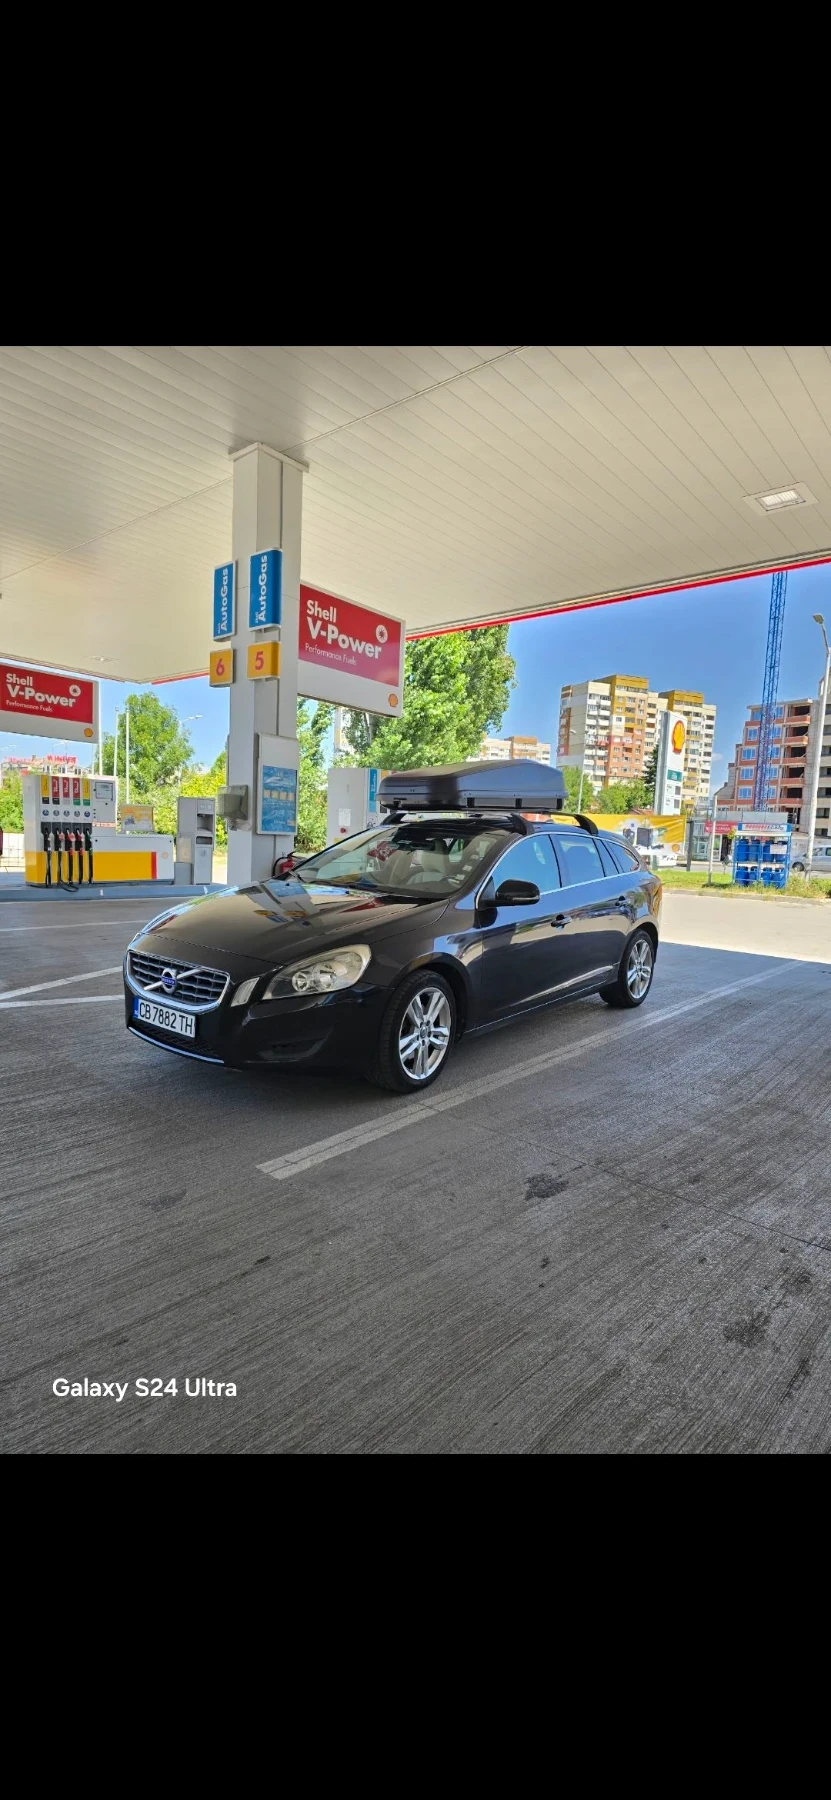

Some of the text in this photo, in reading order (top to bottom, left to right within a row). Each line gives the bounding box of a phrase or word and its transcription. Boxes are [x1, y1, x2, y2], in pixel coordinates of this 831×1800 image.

[220, 568, 228, 632] AutoGas
[258, 555, 268, 622] AutoGas
[306, 599, 337, 622] Shell
[306, 616, 383, 659] V-Power
[254, 650, 264, 671] 5
[305, 643, 357, 666] Performance Fuels
[215, 658, 225, 677] 6
[5, 673, 33, 687] Shell
[8, 684, 76, 708] V-Power
[139, 1003, 193, 1034] CB 7882 TH
